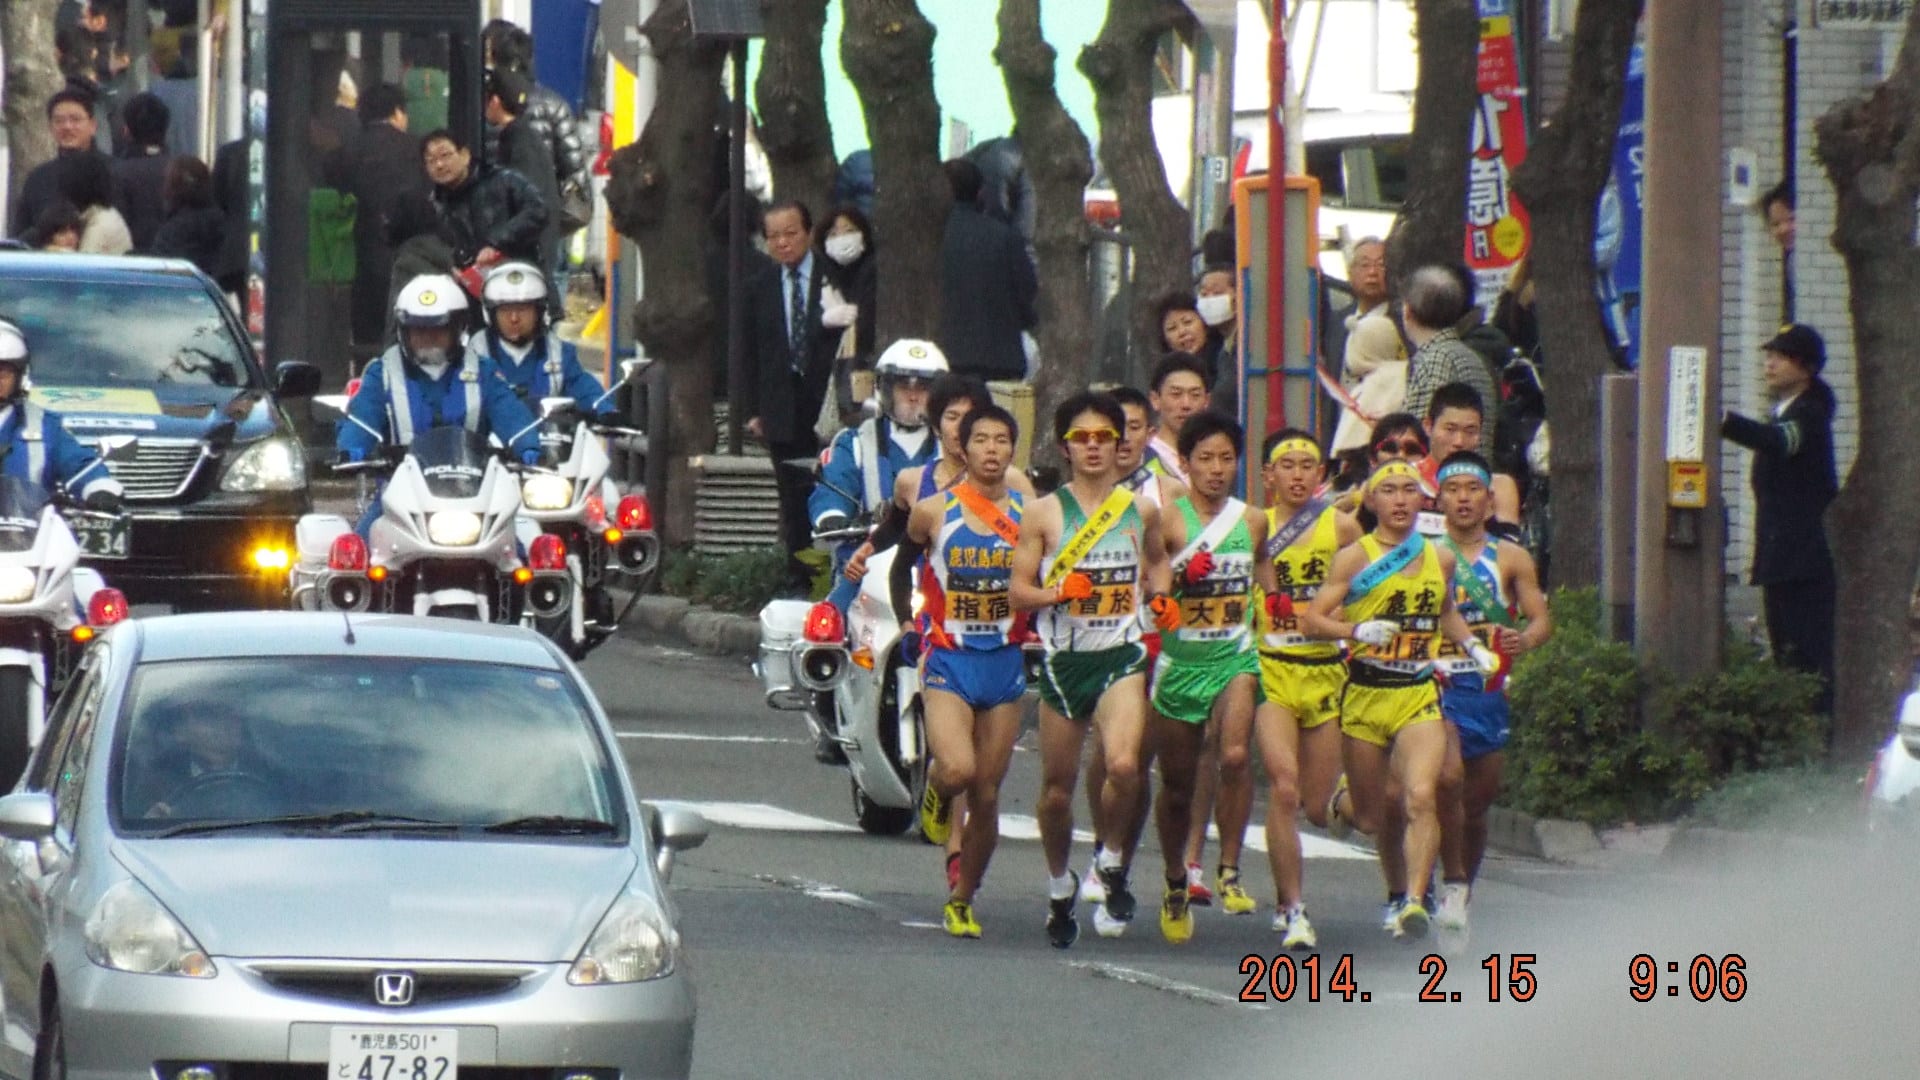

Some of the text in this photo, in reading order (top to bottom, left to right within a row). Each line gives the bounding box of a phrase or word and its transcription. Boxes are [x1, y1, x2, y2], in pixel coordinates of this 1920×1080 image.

[423, 465, 483, 477] POLICE
[99, 531, 126, 555] 34
[953, 594, 1009, 623] 指宿
[1187, 601, 1243, 624] 大島
[358, 1055, 449, 1080] 47-82
